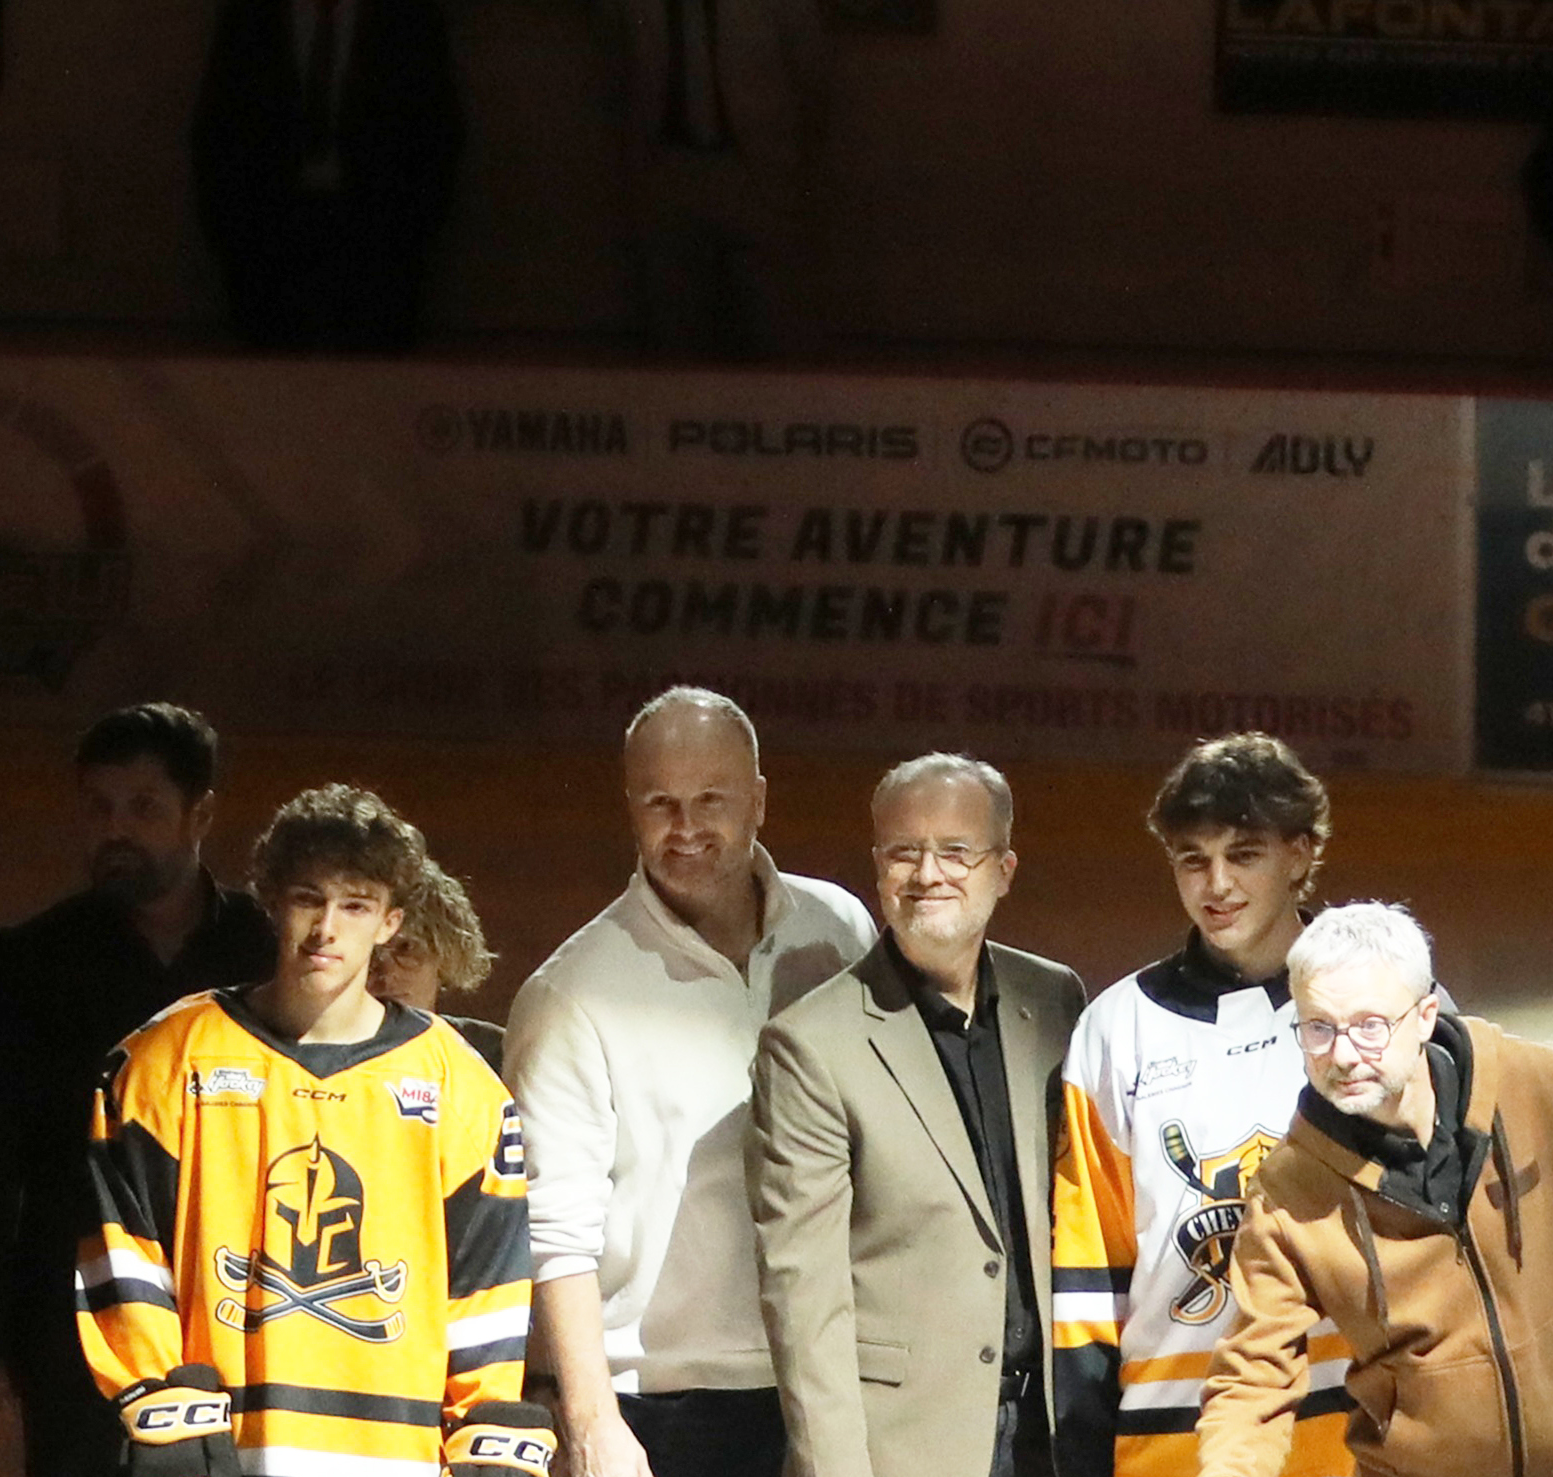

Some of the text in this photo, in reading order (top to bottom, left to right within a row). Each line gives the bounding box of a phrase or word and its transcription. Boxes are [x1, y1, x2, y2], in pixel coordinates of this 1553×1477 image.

[467, 410, 1375, 477] YAMAHA POLARIS CFMOTO ADLY
[521, 498, 1202, 574] VOTRE AVENTURE
[580, 576, 1136, 648] COMMENCE ICI
[892, 682, 948, 724] DE
[964, 682, 1140, 730] SPORTS
[1154, 685, 1414, 741] MOTORISÉS
[1227, 1035, 1278, 1056] CCM
[292, 1088, 347, 1103] CCM
